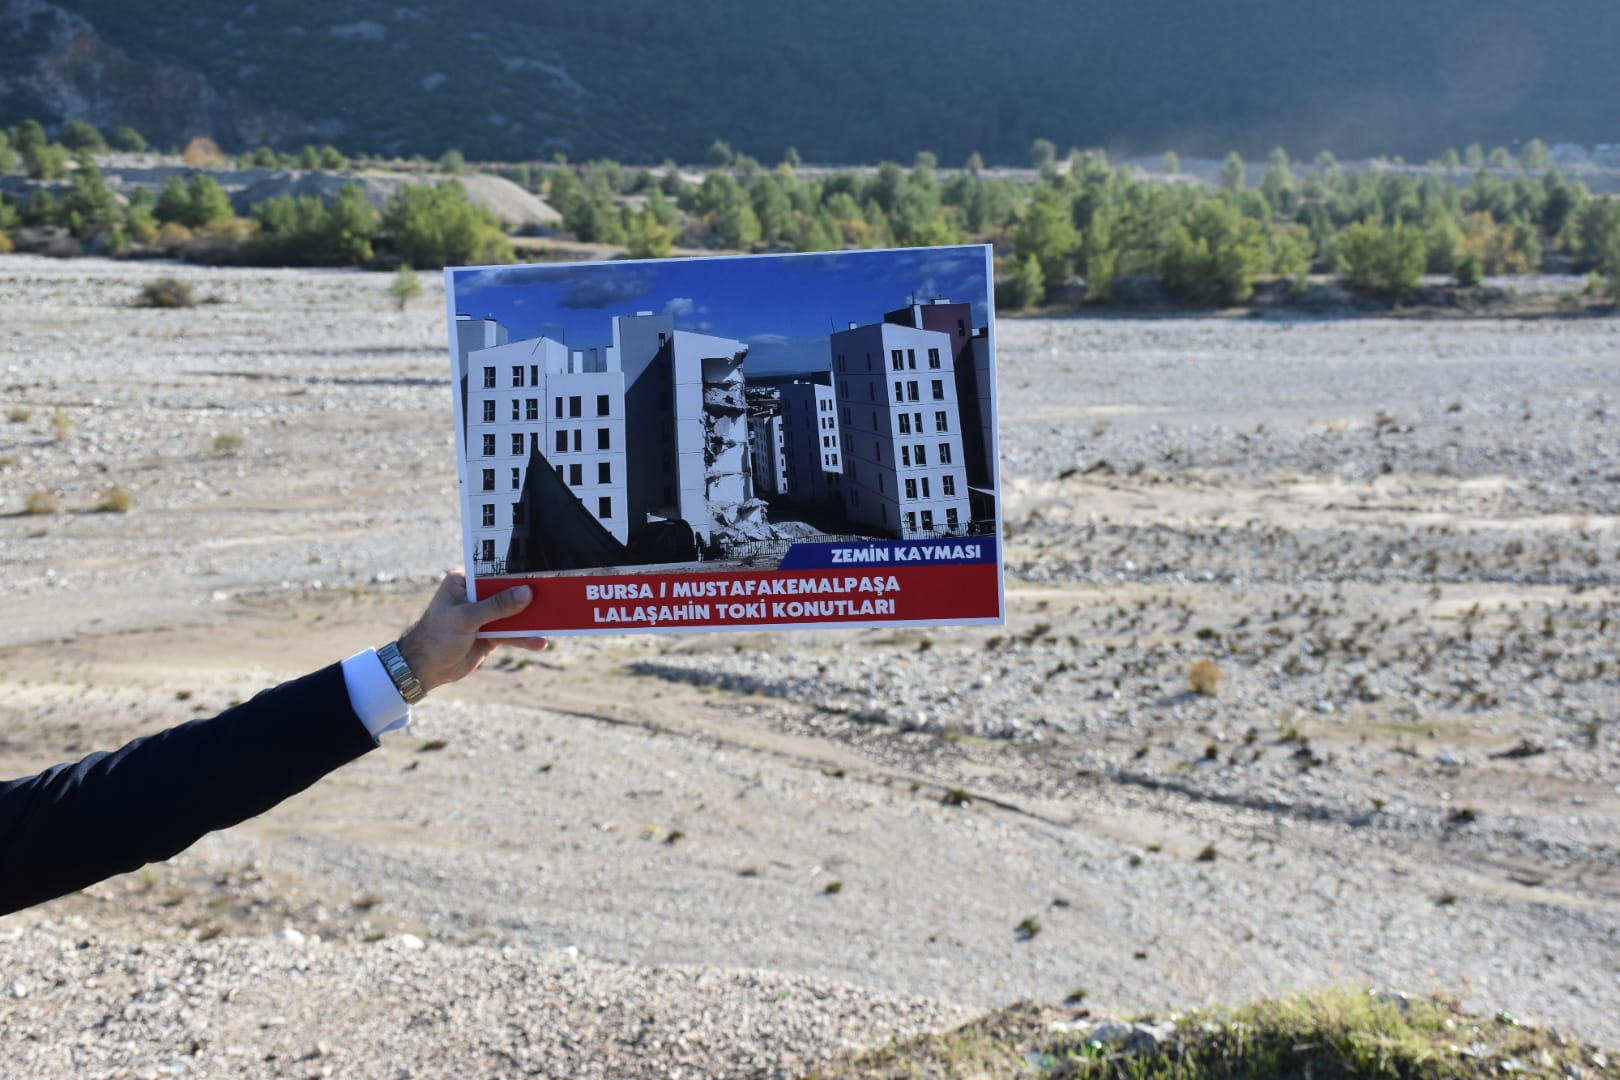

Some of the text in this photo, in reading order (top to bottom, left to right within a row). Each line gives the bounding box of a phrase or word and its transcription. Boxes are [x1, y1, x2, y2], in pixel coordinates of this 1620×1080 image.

[831, 544, 981, 563] ZEMİN KAYMASI
[586, 583, 654, 600] BURSA
[672, 576, 901, 598] MUSTAFAKEMALPAŞA
[593, 598, 896, 626] LALAŞAHİN TOKİ KONUTLARI
